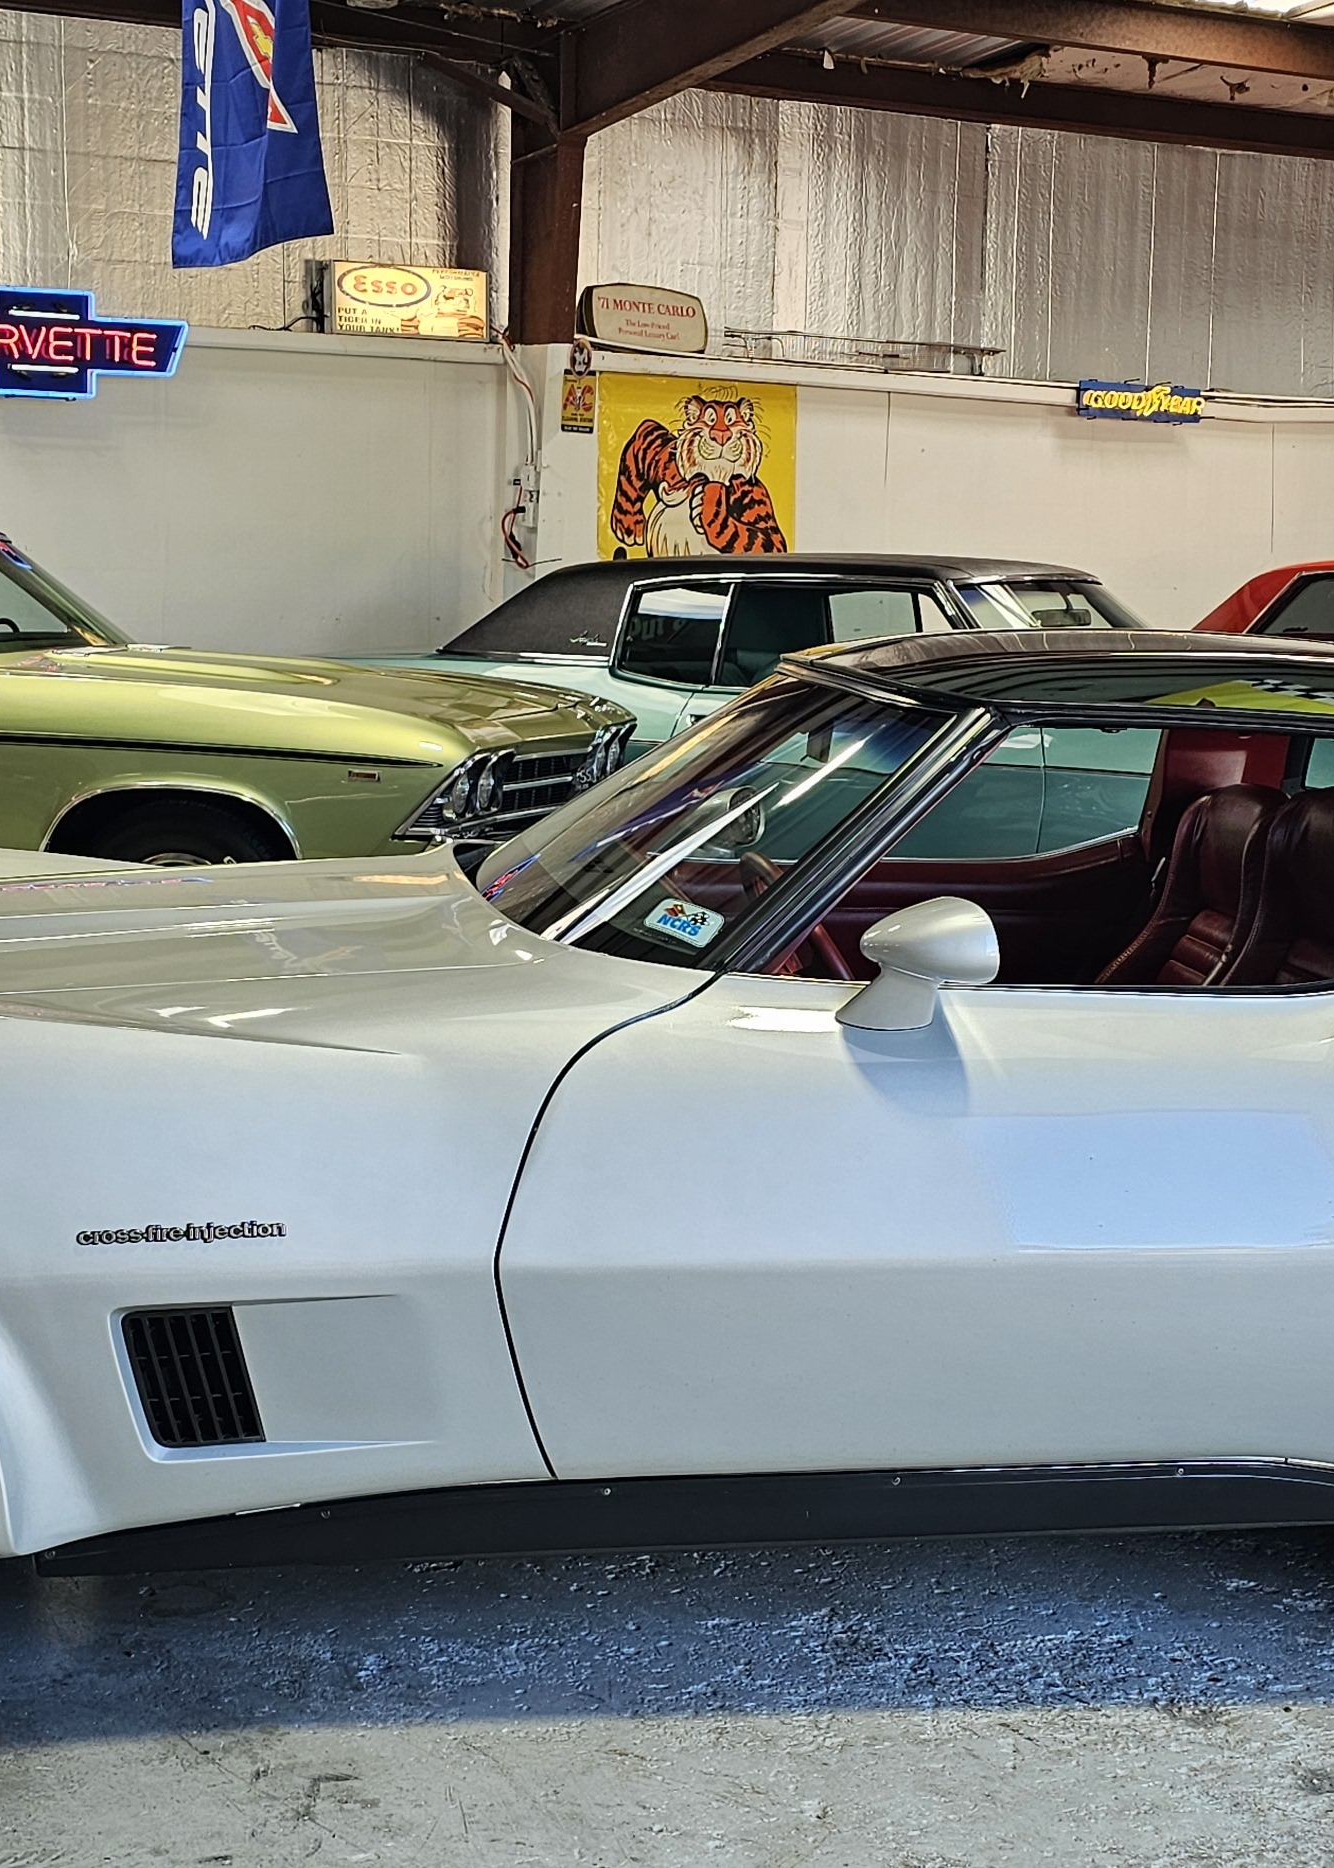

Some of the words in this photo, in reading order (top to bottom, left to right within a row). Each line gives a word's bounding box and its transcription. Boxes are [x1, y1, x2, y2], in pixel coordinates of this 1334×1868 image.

[190, 0, 216, 240] ETTE
[337, 306, 357, 315] PUT
[361, 308, 368, 316] A
[613, 299, 655, 315] MONTE
[657, 303, 696, 318] CARLO
[1083, 386, 1206, 416] GOODYEAR
[656, 913, 702, 937] NCRS
